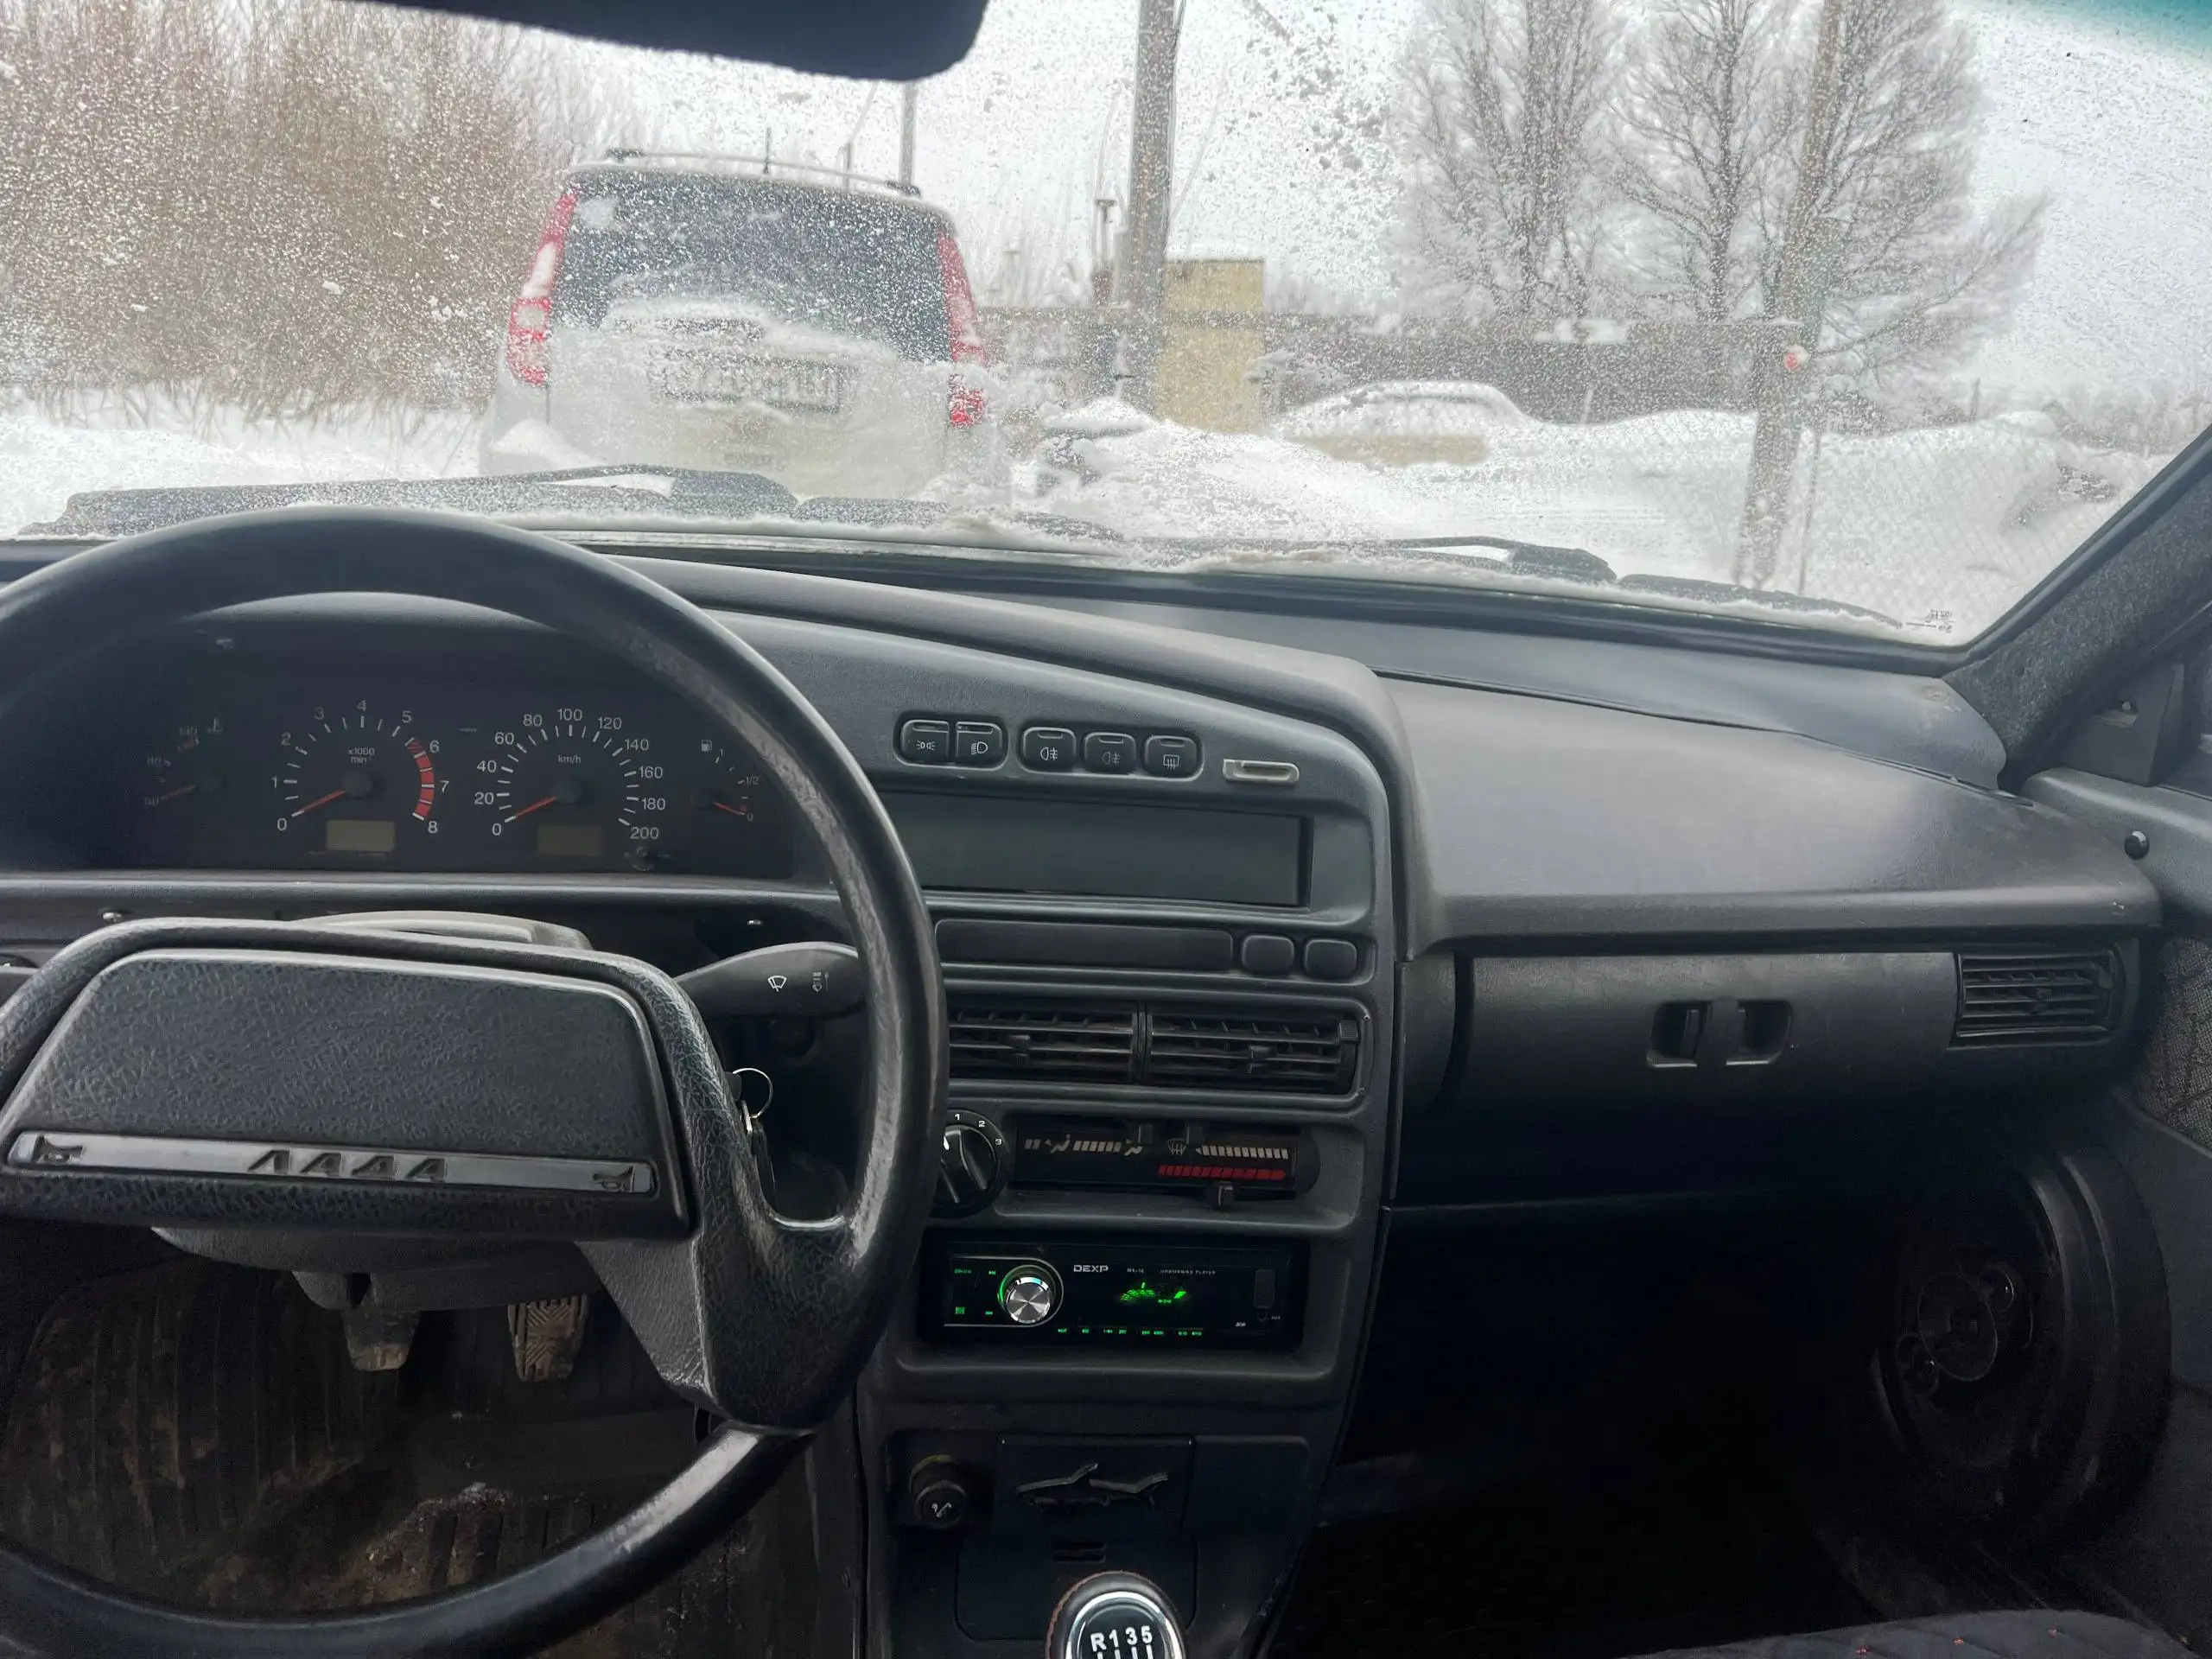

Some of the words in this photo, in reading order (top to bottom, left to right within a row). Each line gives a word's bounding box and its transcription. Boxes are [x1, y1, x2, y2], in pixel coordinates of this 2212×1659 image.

[356, 700, 367, 711] 4
[314, 707, 325, 721] 3
[402, 710, 412, 723] 5
[556, 709, 582, 721] 100
[522, 714, 543, 728] 80
[597, 717, 622, 730] 120
[281, 733, 292, 747] 2
[494, 732, 515, 745] 60
[429, 741, 440, 753] 6
[625, 739, 650, 752] 140
[476, 760, 497, 773] 40
[638, 766, 664, 779] 160
[271, 777, 277, 789] 1
[440, 780, 450, 792] 7
[474, 791, 494, 805] 20
[641, 798, 666, 811] 180
[276, 817, 287, 831] 0
[427, 821, 438, 835] 8
[491, 823, 502, 836] 0
[629, 826, 659, 840] 200
[1073, 1264, 1109, 1273] DEXP
[1090, 1632, 1107, 1652] R
[1109, 1629, 1120, 1648] 1
[1125, 1626, 1138, 1645] 3
[1141, 1625, 1153, 1643] 5
